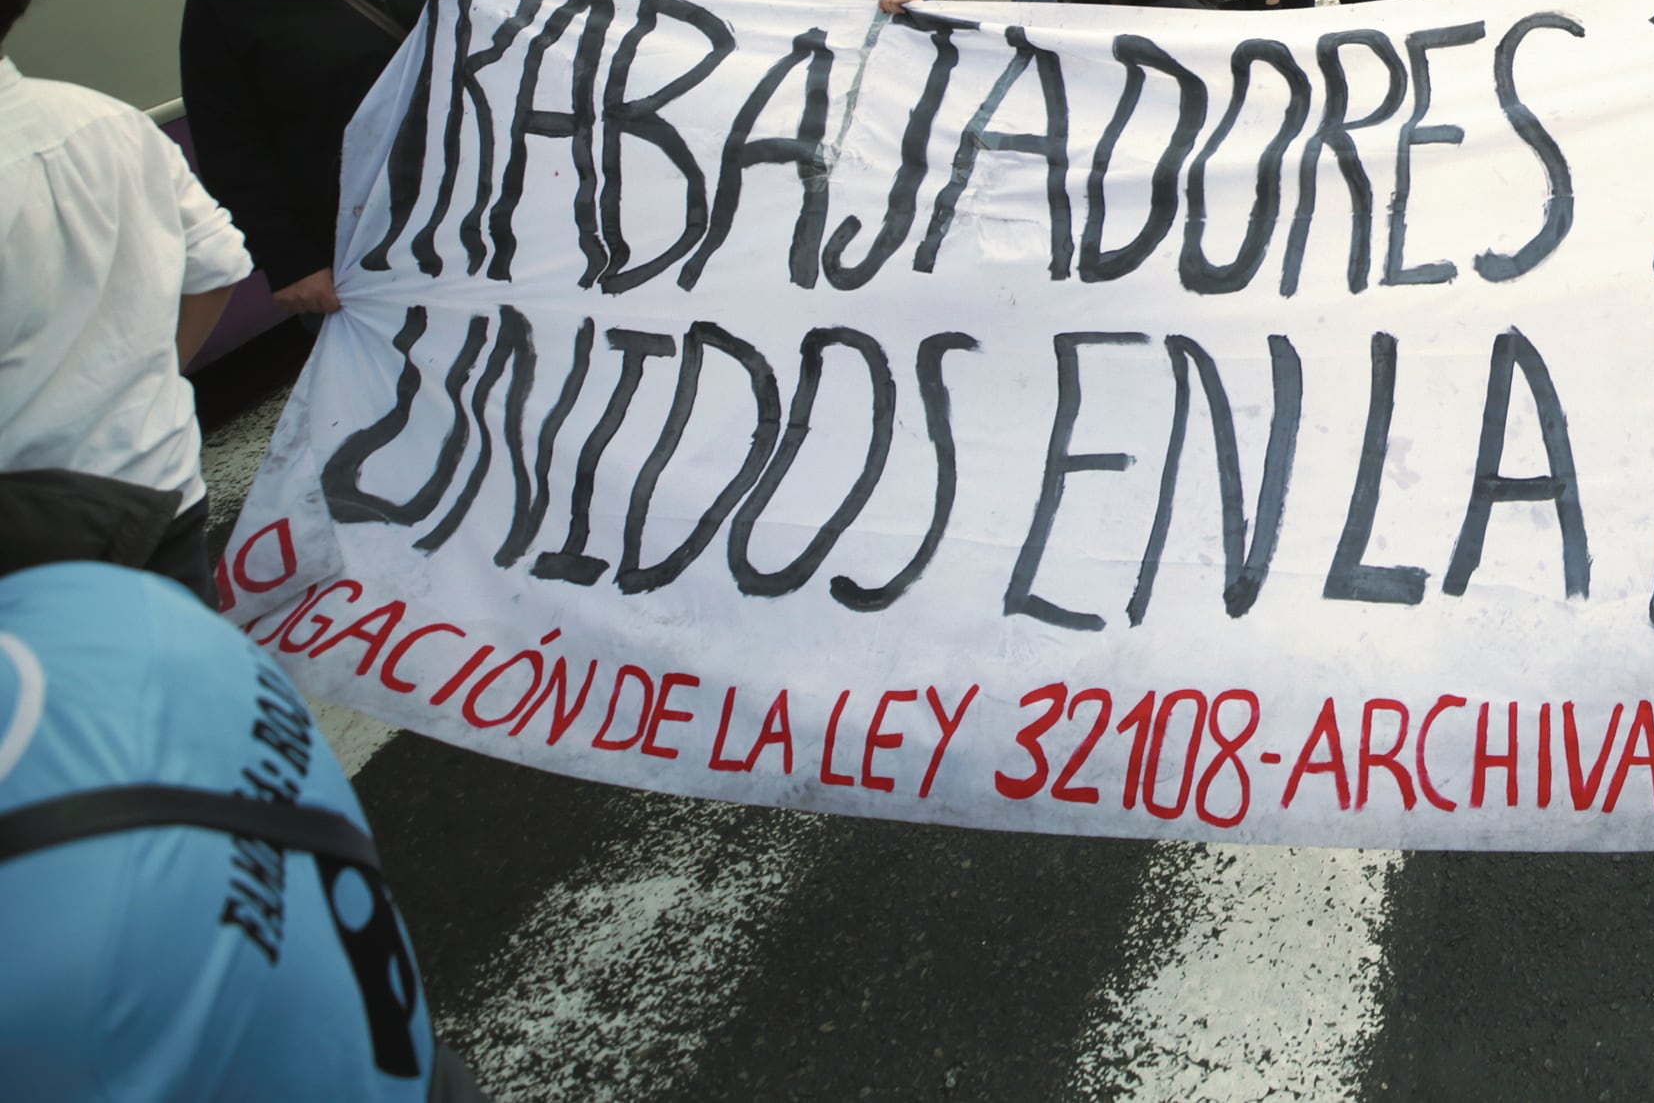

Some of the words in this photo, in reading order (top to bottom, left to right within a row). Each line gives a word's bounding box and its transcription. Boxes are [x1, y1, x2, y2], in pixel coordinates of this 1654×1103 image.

[321, 304, 981, 612] UNIDOS
[1003, 330, 1302, 631] EN
[1323, 325, 1590, 604] LA
[591, 664, 700, 759] DE
[708, 686, 792, 774] LA
[820, 684, 979, 798] LEY
